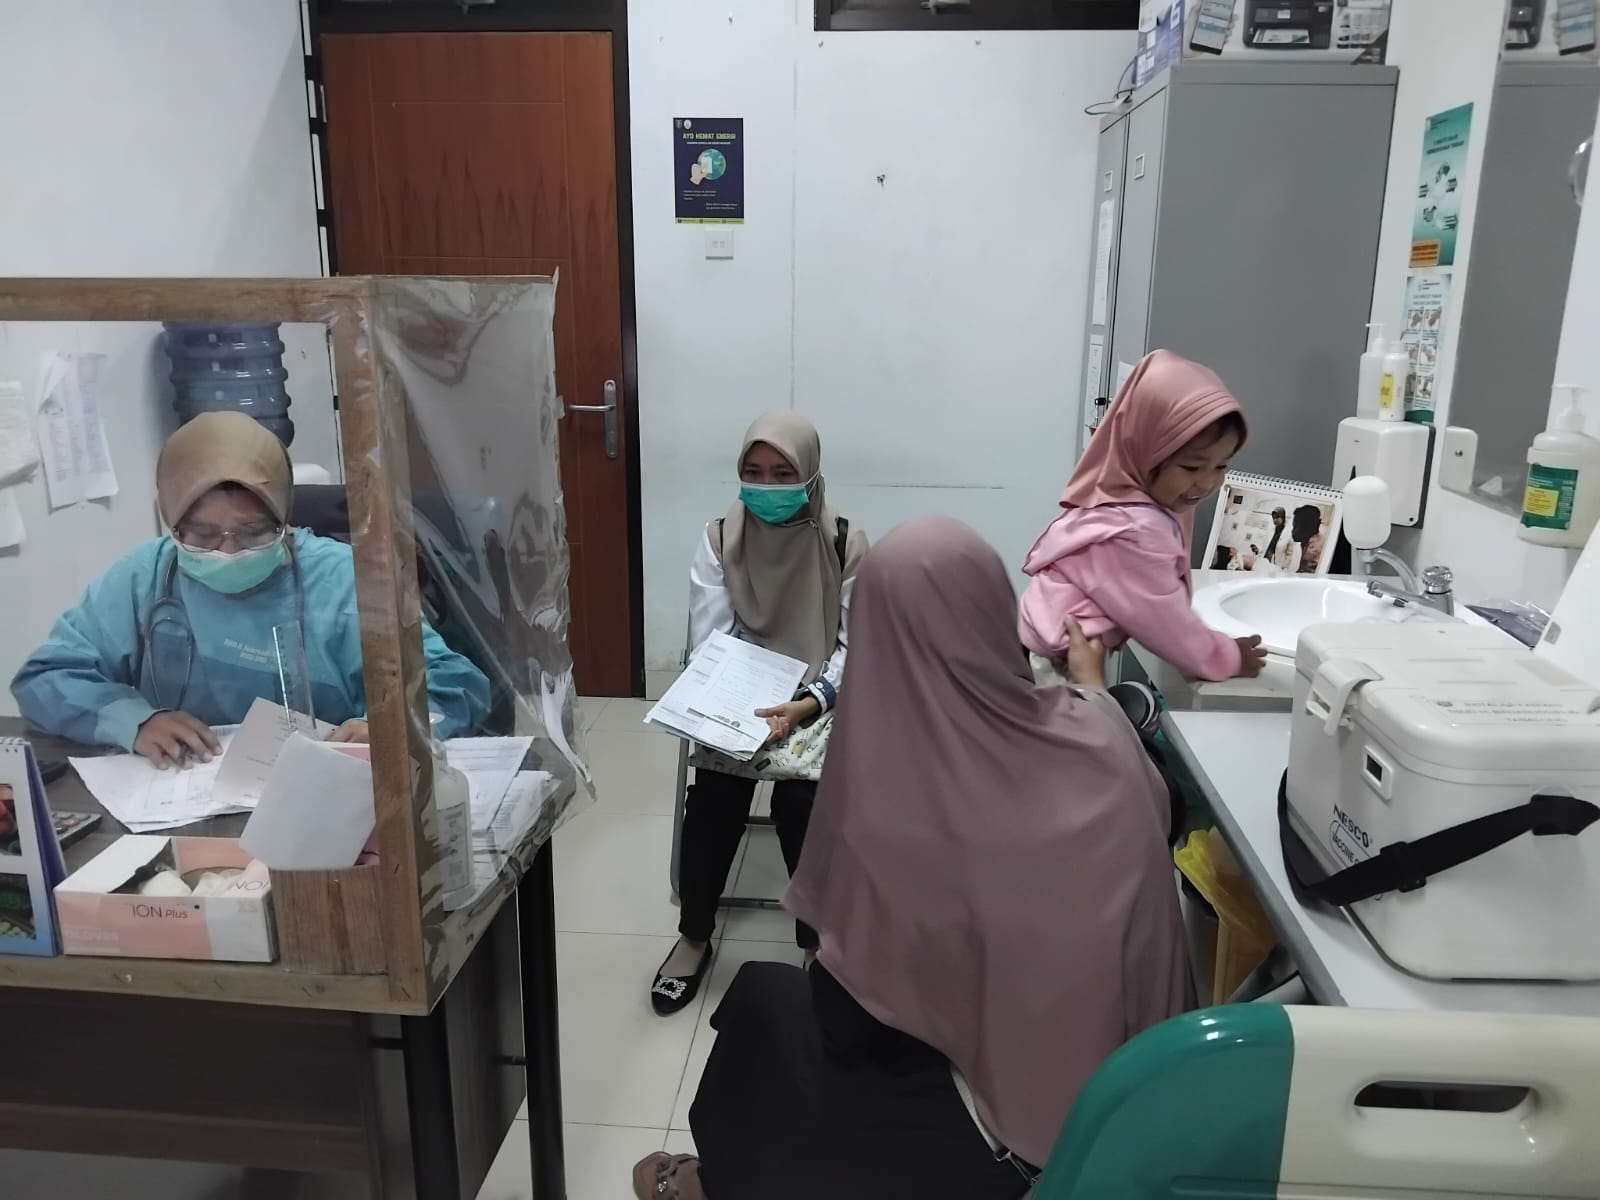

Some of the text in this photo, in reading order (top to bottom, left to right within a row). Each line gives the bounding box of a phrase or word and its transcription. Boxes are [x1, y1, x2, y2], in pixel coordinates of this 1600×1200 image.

[1333, 803, 1369, 848] NESCO
[131, 904, 188, 919] ION Plus
